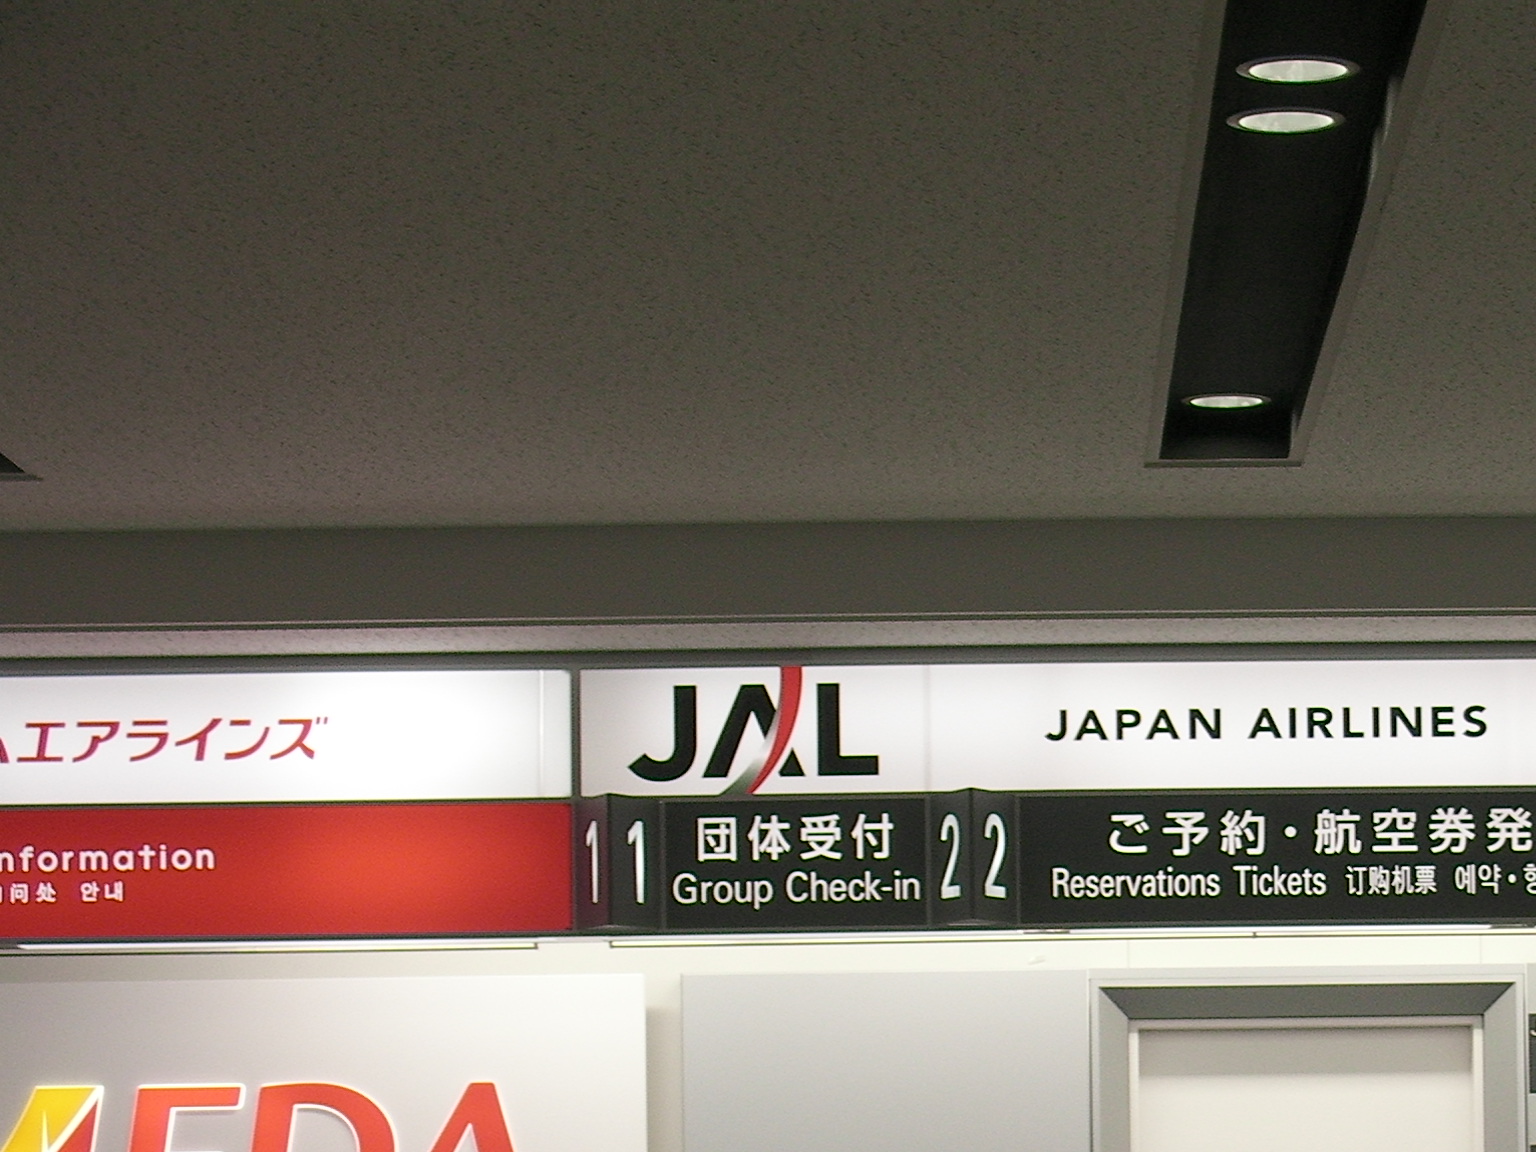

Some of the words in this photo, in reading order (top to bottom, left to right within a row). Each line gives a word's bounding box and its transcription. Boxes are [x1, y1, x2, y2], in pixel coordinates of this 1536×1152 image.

[0, 717, 328, 763] エアラインズ
[628, 682, 880, 782] JAL
[1045, 707, 1222, 742] JAPAN
[1248, 704, 1489, 740] AIRLINES
[696, 812, 894, 862] 団体受付
[939, 813, 961, 901] 2
[983, 812, 1008, 899] 2
[585, 819, 599, 905] 1
[627, 819, 646, 905] 1
[1052, 864, 1221, 899] Reservations
[1233, 862, 1327, 898] Tickets
[1346, 863, 1437, 896] 订购机票
[0, 882, 57, 904] 问处
[80, 880, 124, 902] 안내
[672, 871, 774, 911] Group
[785, 870, 921, 903] Check-in
